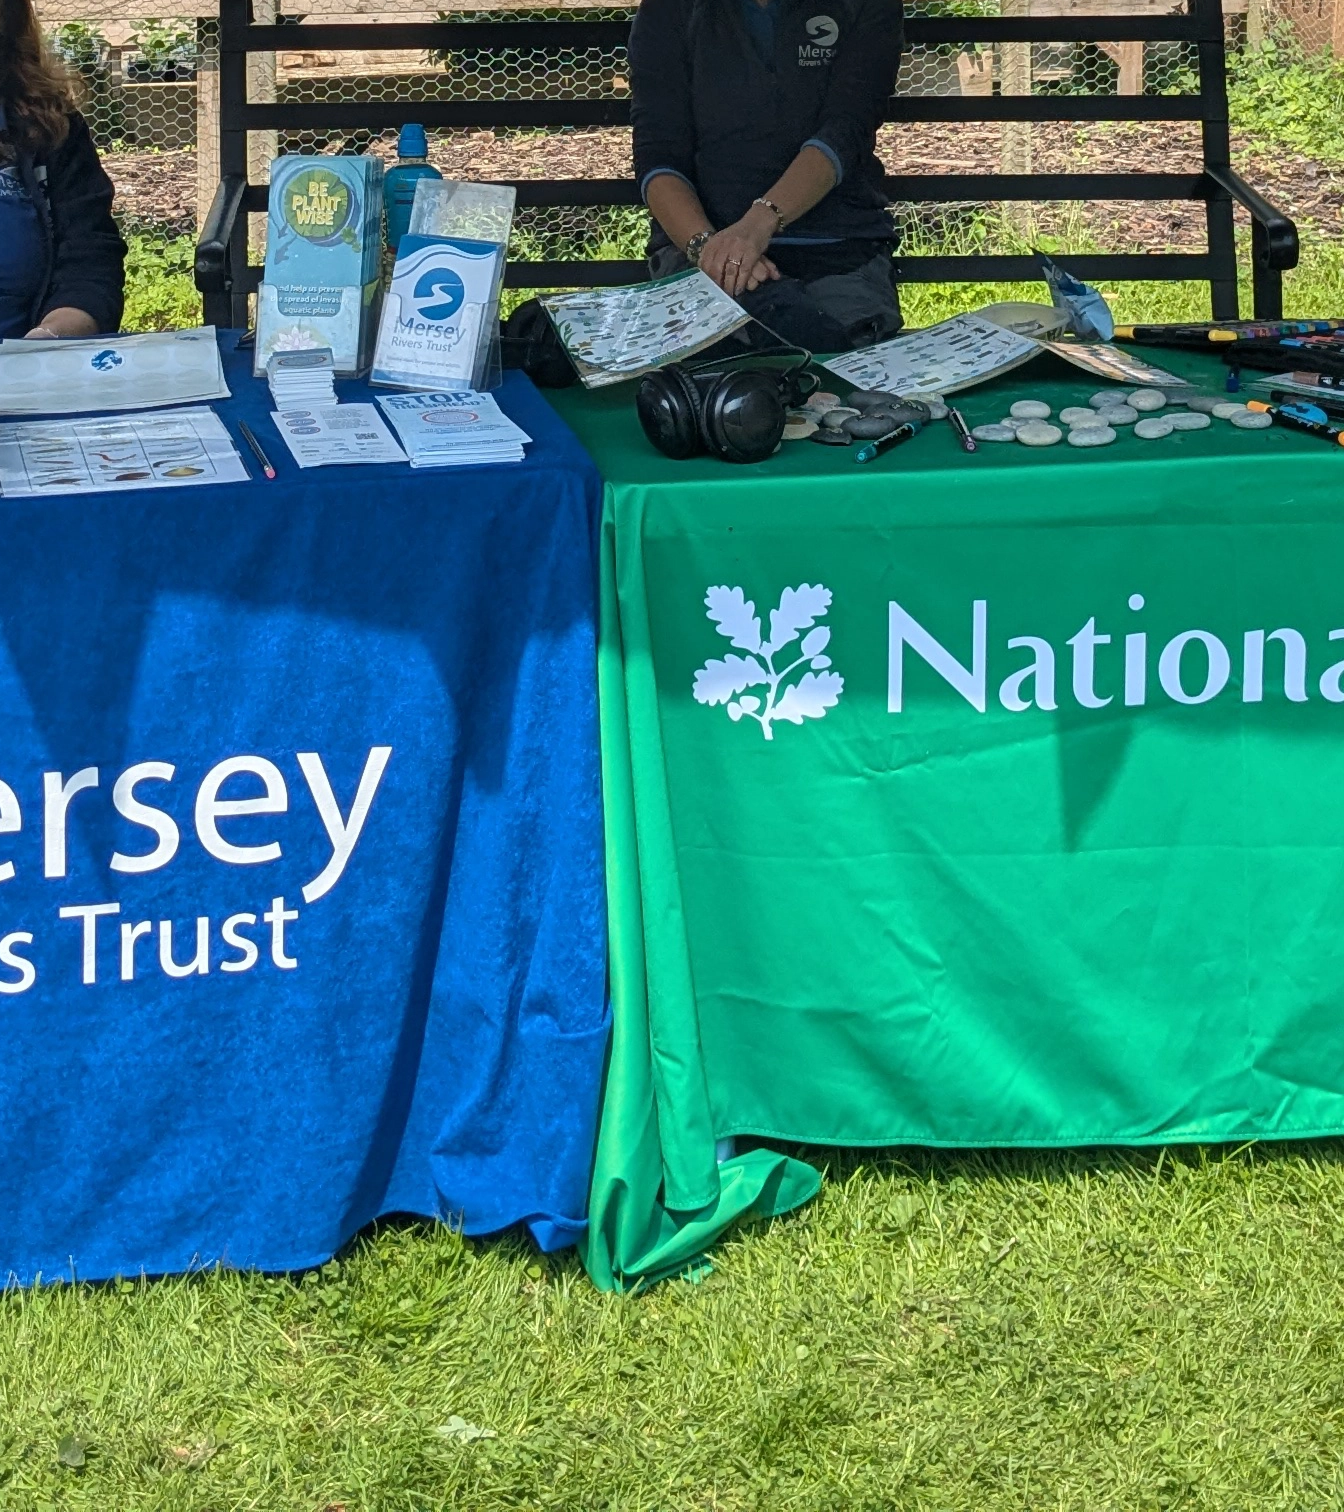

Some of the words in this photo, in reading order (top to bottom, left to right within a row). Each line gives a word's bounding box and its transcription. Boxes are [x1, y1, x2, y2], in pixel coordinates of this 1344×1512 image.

[308, 181, 329, 197] BE
[292, 194, 342, 212] PLANT
[296, 208, 334, 226] WISE
[291, 284, 307, 294] help
[284, 296, 309, 305] spread
[393, 318, 467, 345] Mersey
[391, 336, 423, 349] Rivers
[426, 339, 453, 353] Trust
[386, 391, 473, 406] STOP
[58, 896, 299, 985] Trust
